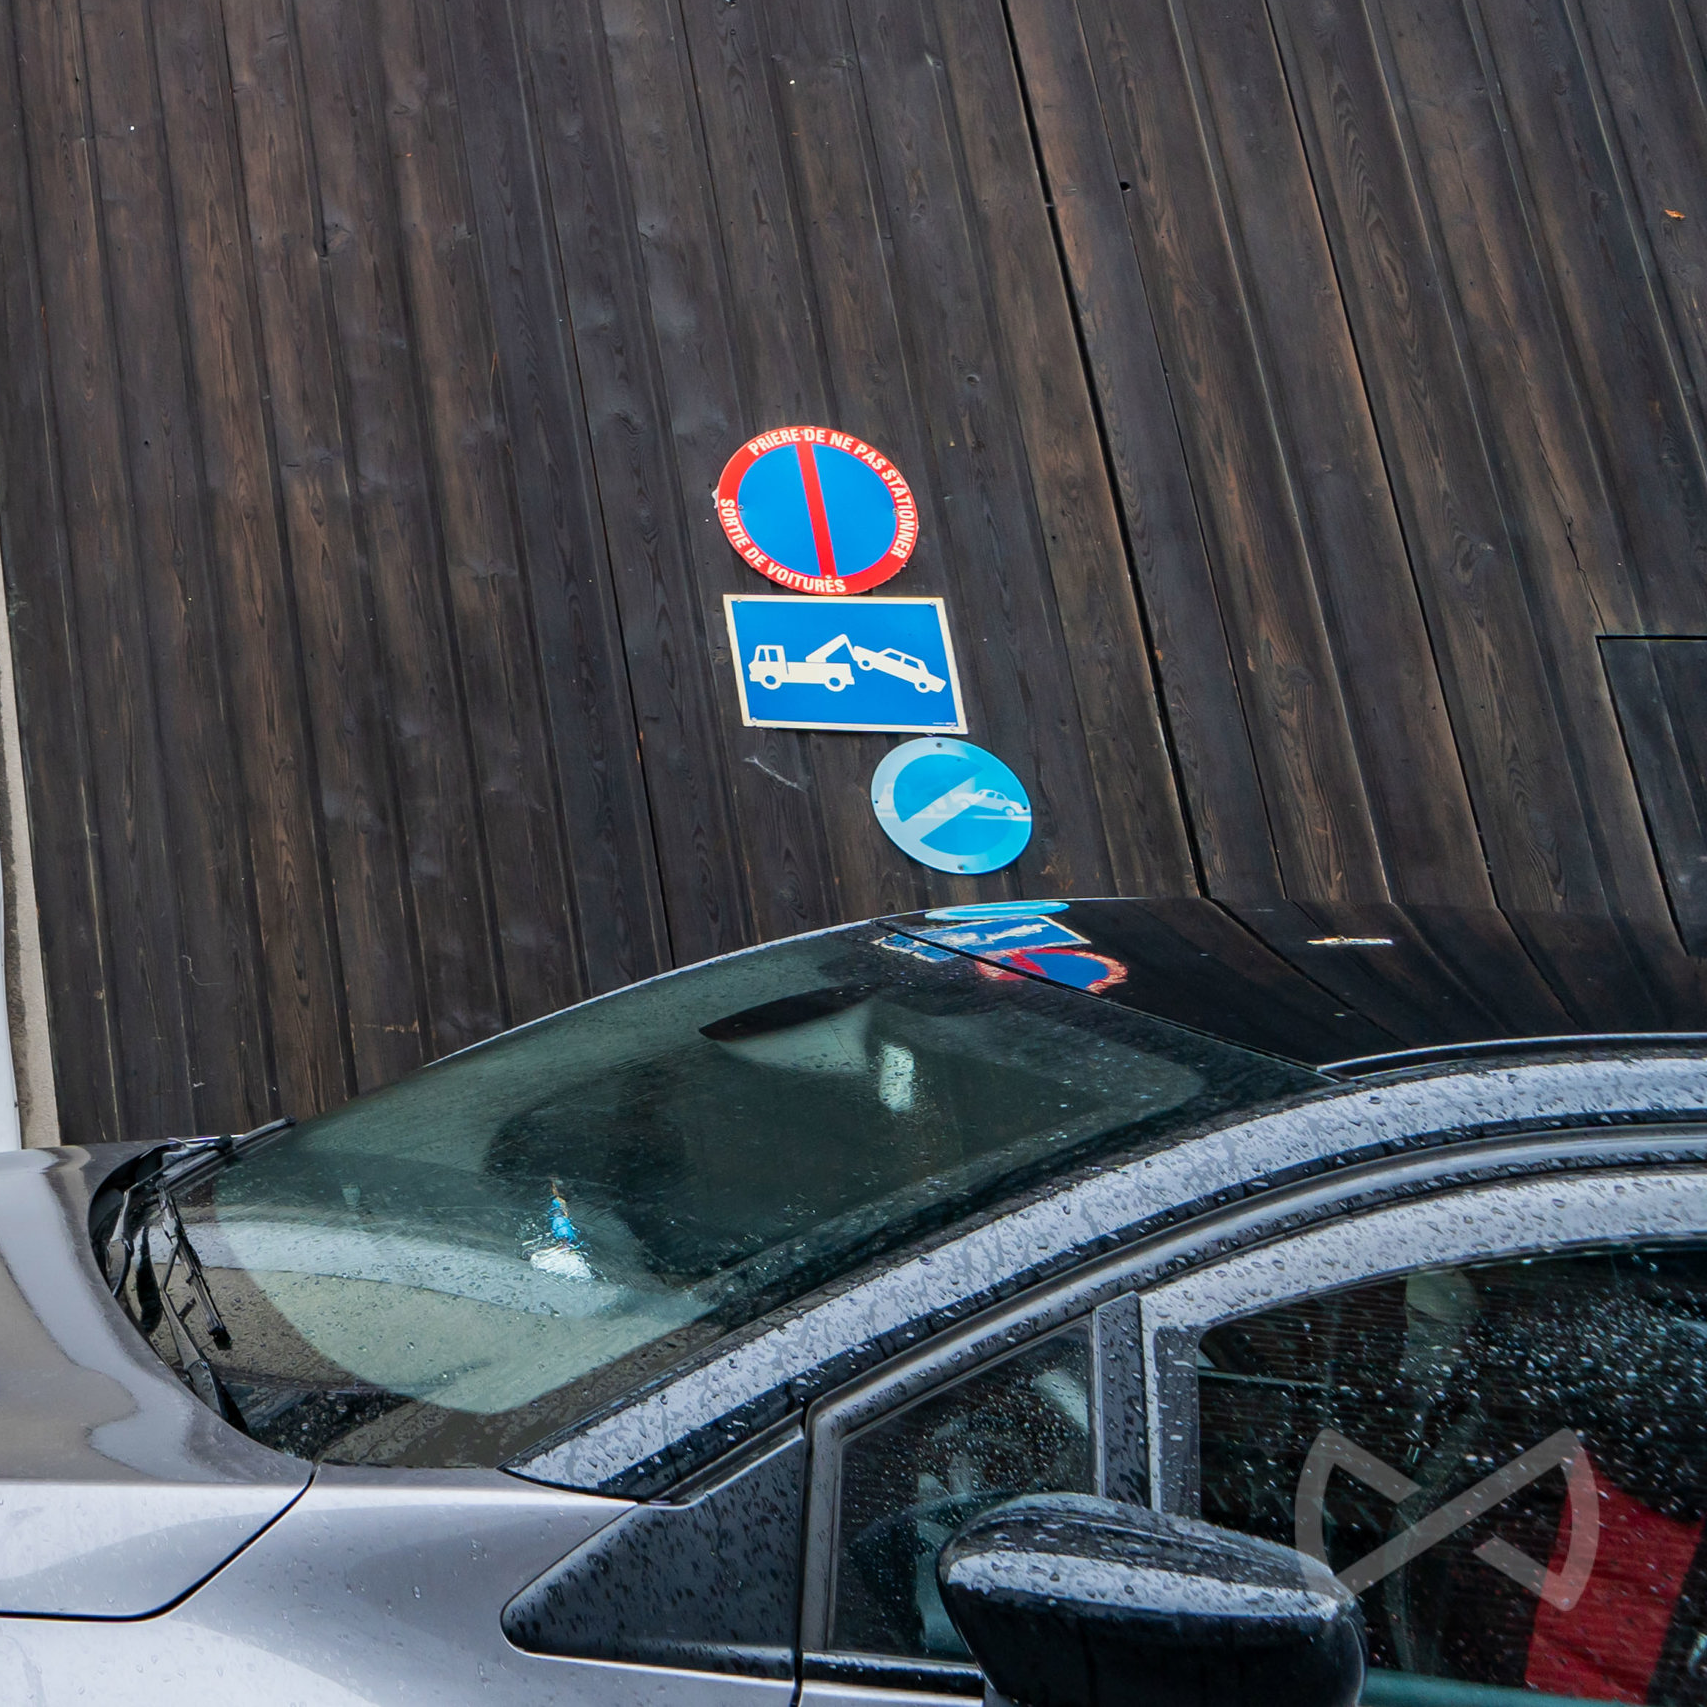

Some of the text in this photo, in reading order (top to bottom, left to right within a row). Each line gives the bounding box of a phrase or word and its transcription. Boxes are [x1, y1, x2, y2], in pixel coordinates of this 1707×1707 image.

[720, 498, 847, 593] SORTIE DE VOITURES
[747, 428, 915, 559] PRIERE DE NE PAS STATIONNER
